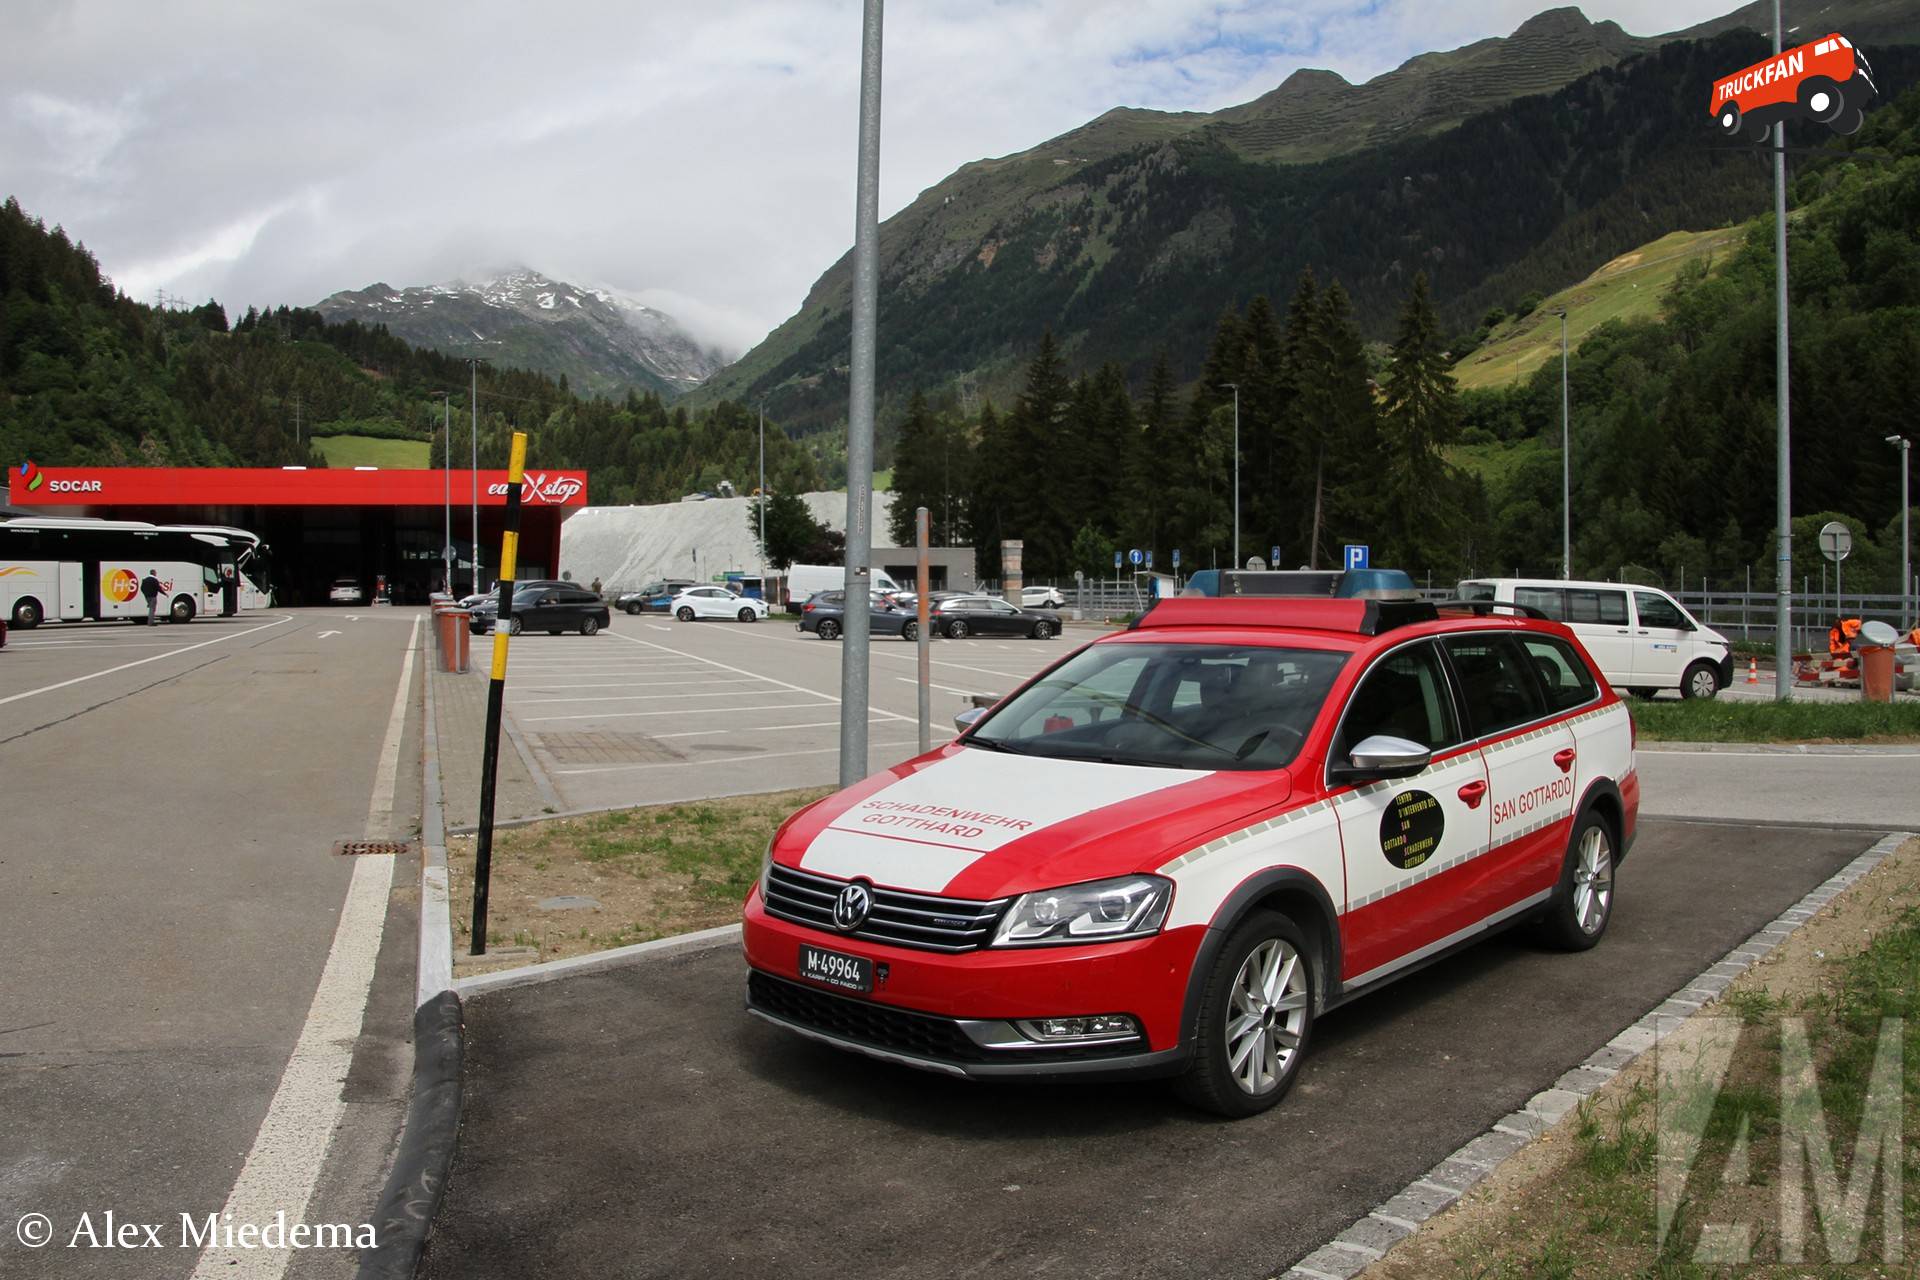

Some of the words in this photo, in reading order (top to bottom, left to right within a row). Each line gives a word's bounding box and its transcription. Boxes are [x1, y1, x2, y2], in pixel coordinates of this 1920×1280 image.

[49, 480, 102, 492] SOCAR
[1350, 548, 1363, 569] P
[1396, 792, 1412, 805] CENTRO
[1398, 800, 1427, 818] D'INTERVENTO
[1427, 797, 1436, 808] DEL
[1493, 799, 1516, 825] SAN
[1519, 776, 1572, 813] GOTTARDO
[862, 800, 1033, 831] SCHADENWEHR
[862, 813, 984, 838] GOTTHARD
[1401, 819, 1411, 831] SAN
[1384, 834, 1407, 851] GOTTARDO
[1404, 836, 1433, 857] SCHADENWEHR
[1404, 852, 1425, 869] GOTTHARD
